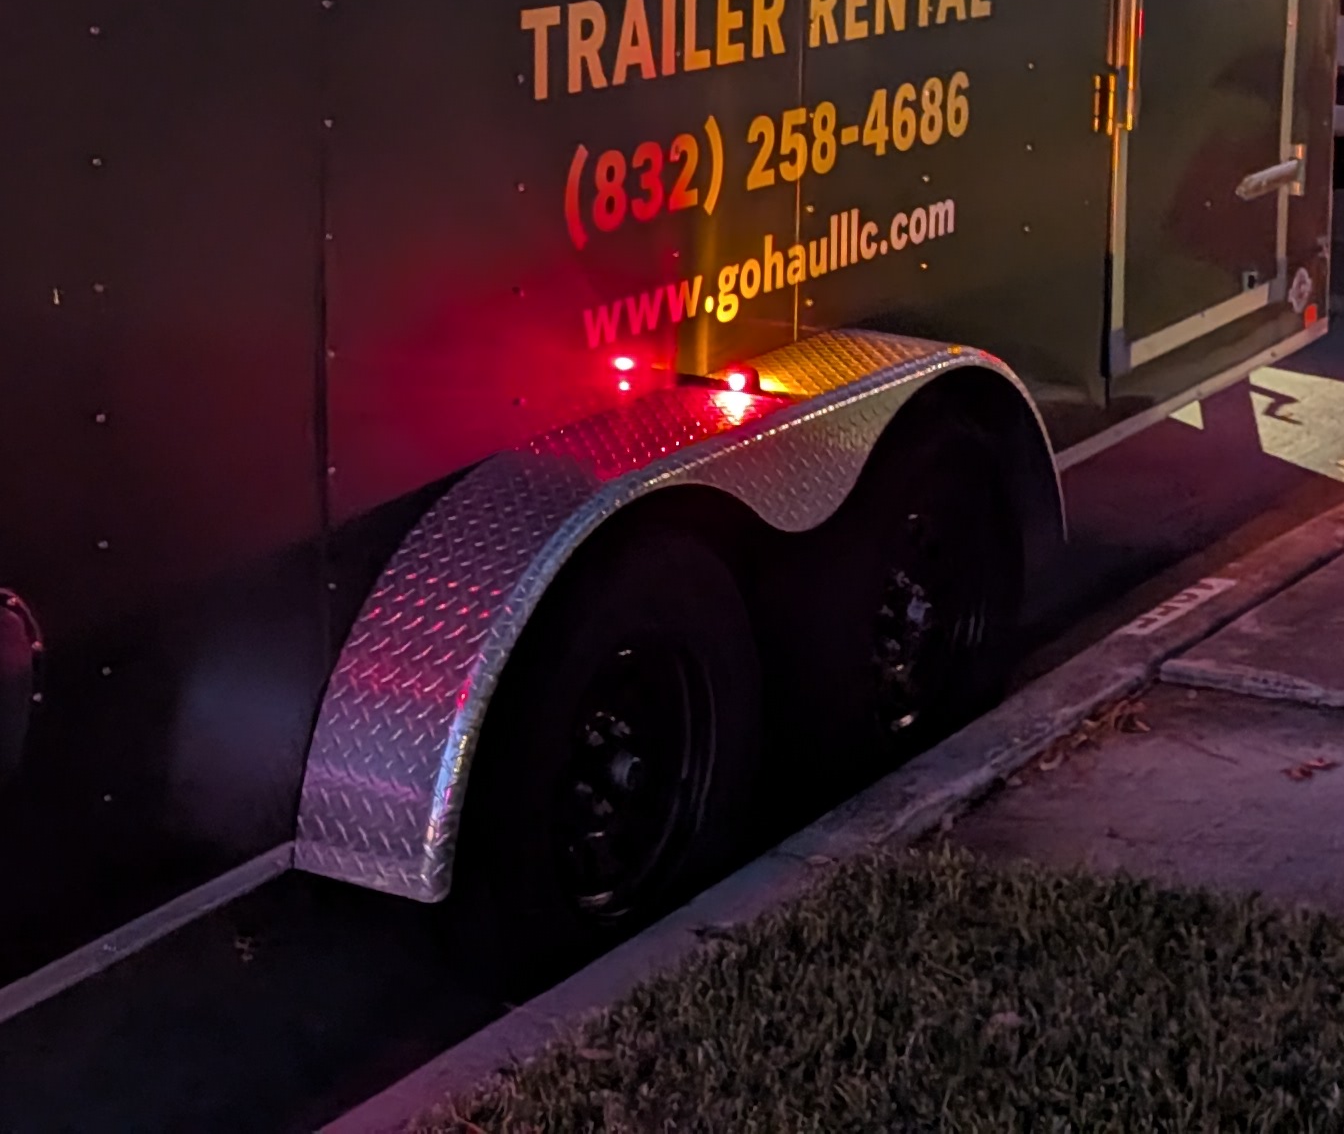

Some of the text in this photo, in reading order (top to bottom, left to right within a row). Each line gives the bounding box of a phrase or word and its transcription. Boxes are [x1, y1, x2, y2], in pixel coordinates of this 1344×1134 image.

[564, 70, 971, 250] (832) 258-4686
[583, 197, 956, 350] www.gohaulllc.com
